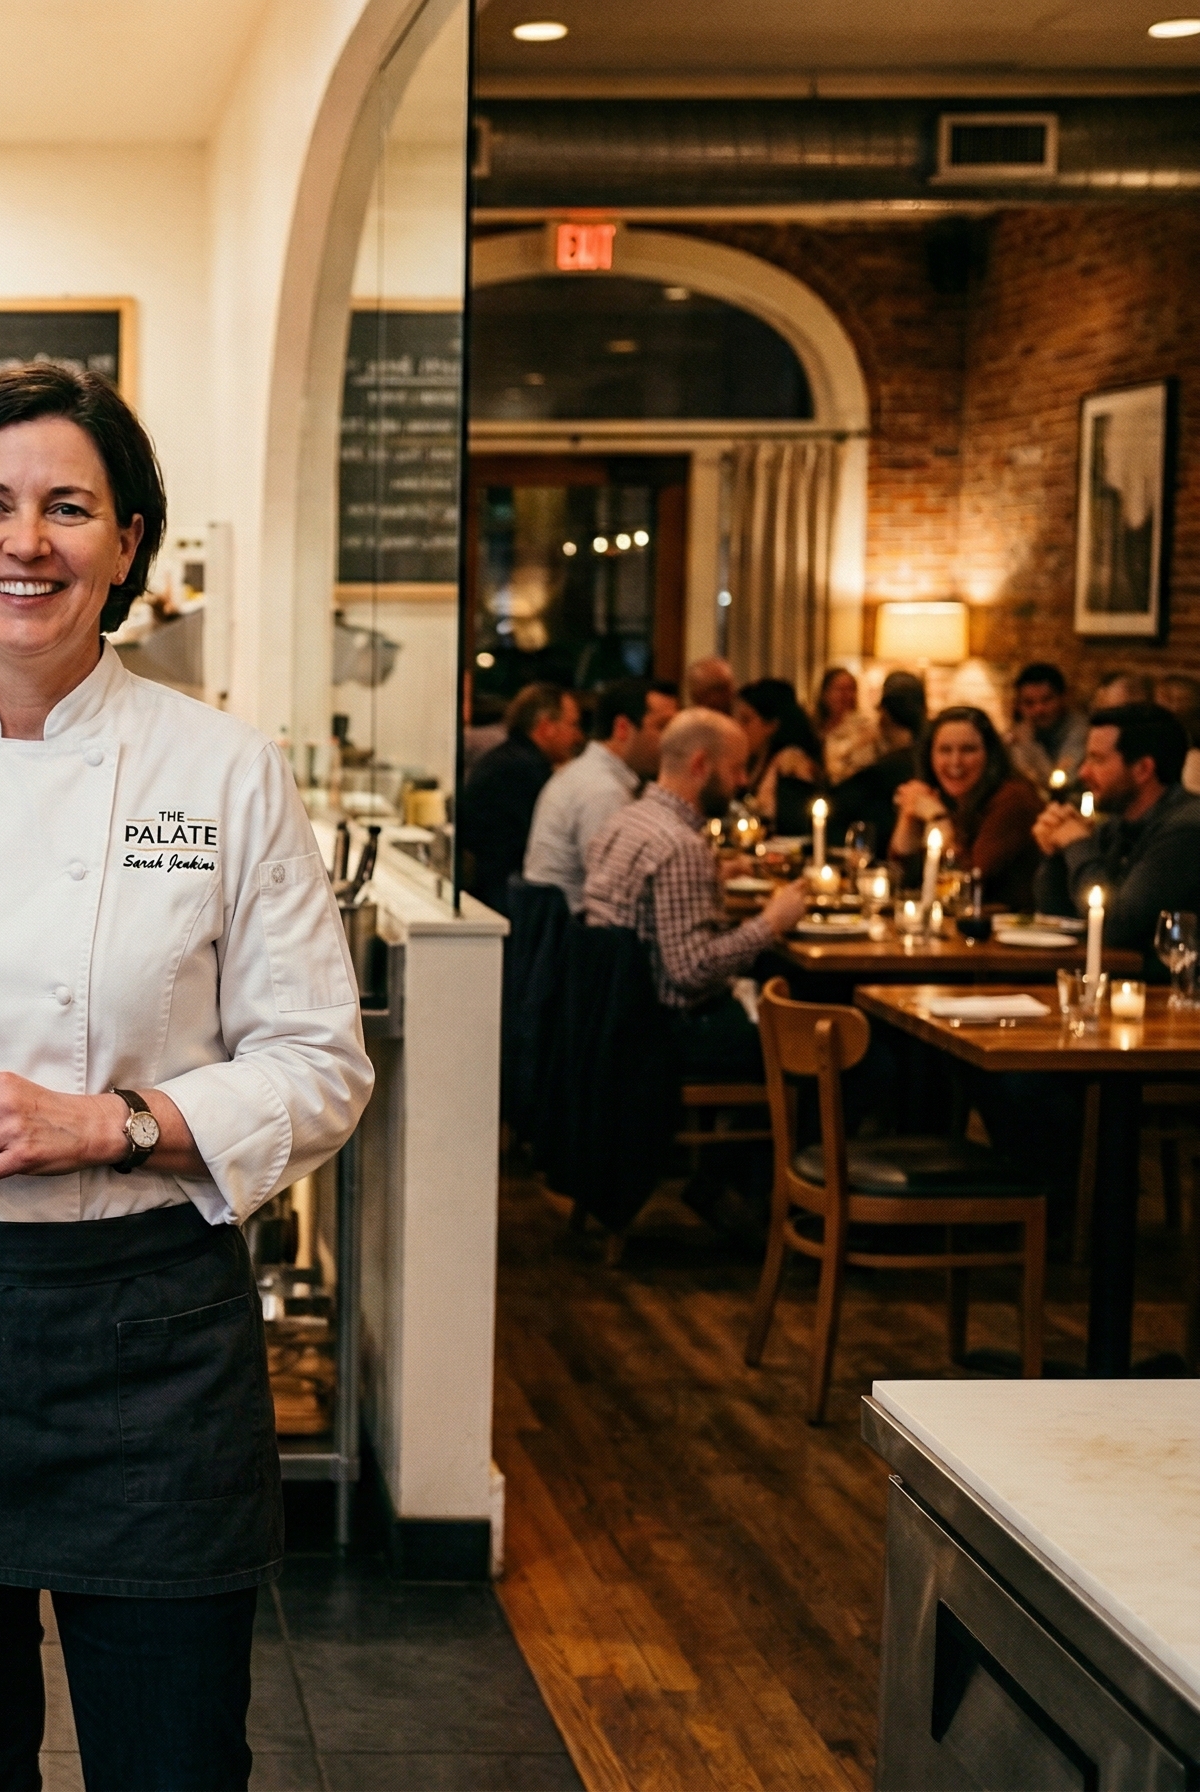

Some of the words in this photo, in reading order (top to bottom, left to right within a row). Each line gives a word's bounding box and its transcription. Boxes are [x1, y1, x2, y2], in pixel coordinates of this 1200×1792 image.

[159, 811, 185, 822] THE
[125, 825, 217, 846] PALATE
[123, 853, 163, 869] Sarah
